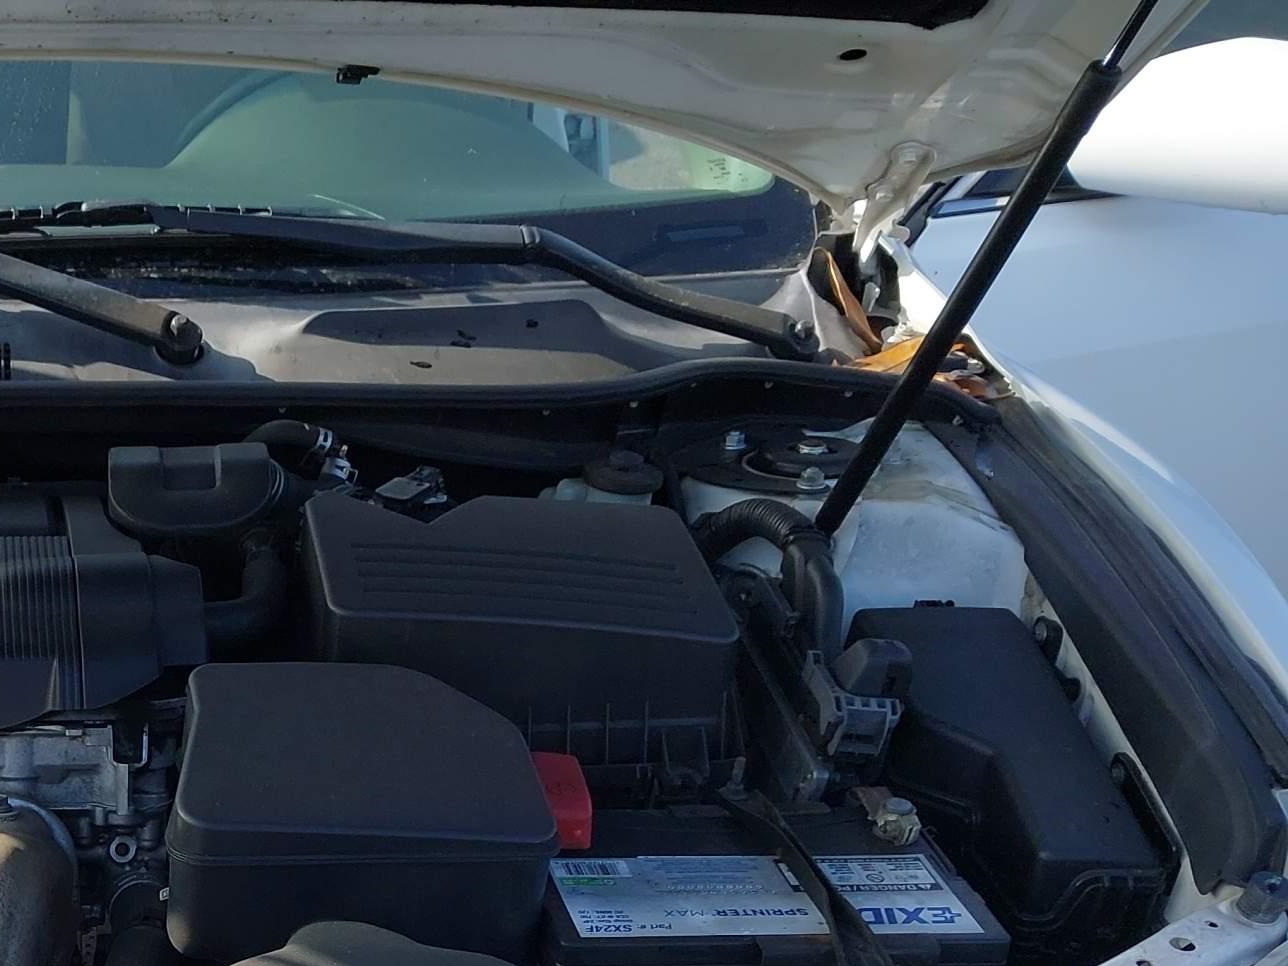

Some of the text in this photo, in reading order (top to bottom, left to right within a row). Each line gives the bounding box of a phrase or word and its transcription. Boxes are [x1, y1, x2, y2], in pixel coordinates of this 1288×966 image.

[664, 909, 704, 918] MAX
[856, 907, 962, 925] EXID
[584, 924, 633, 933] SX24F
[650, 922, 673, 930] Part
